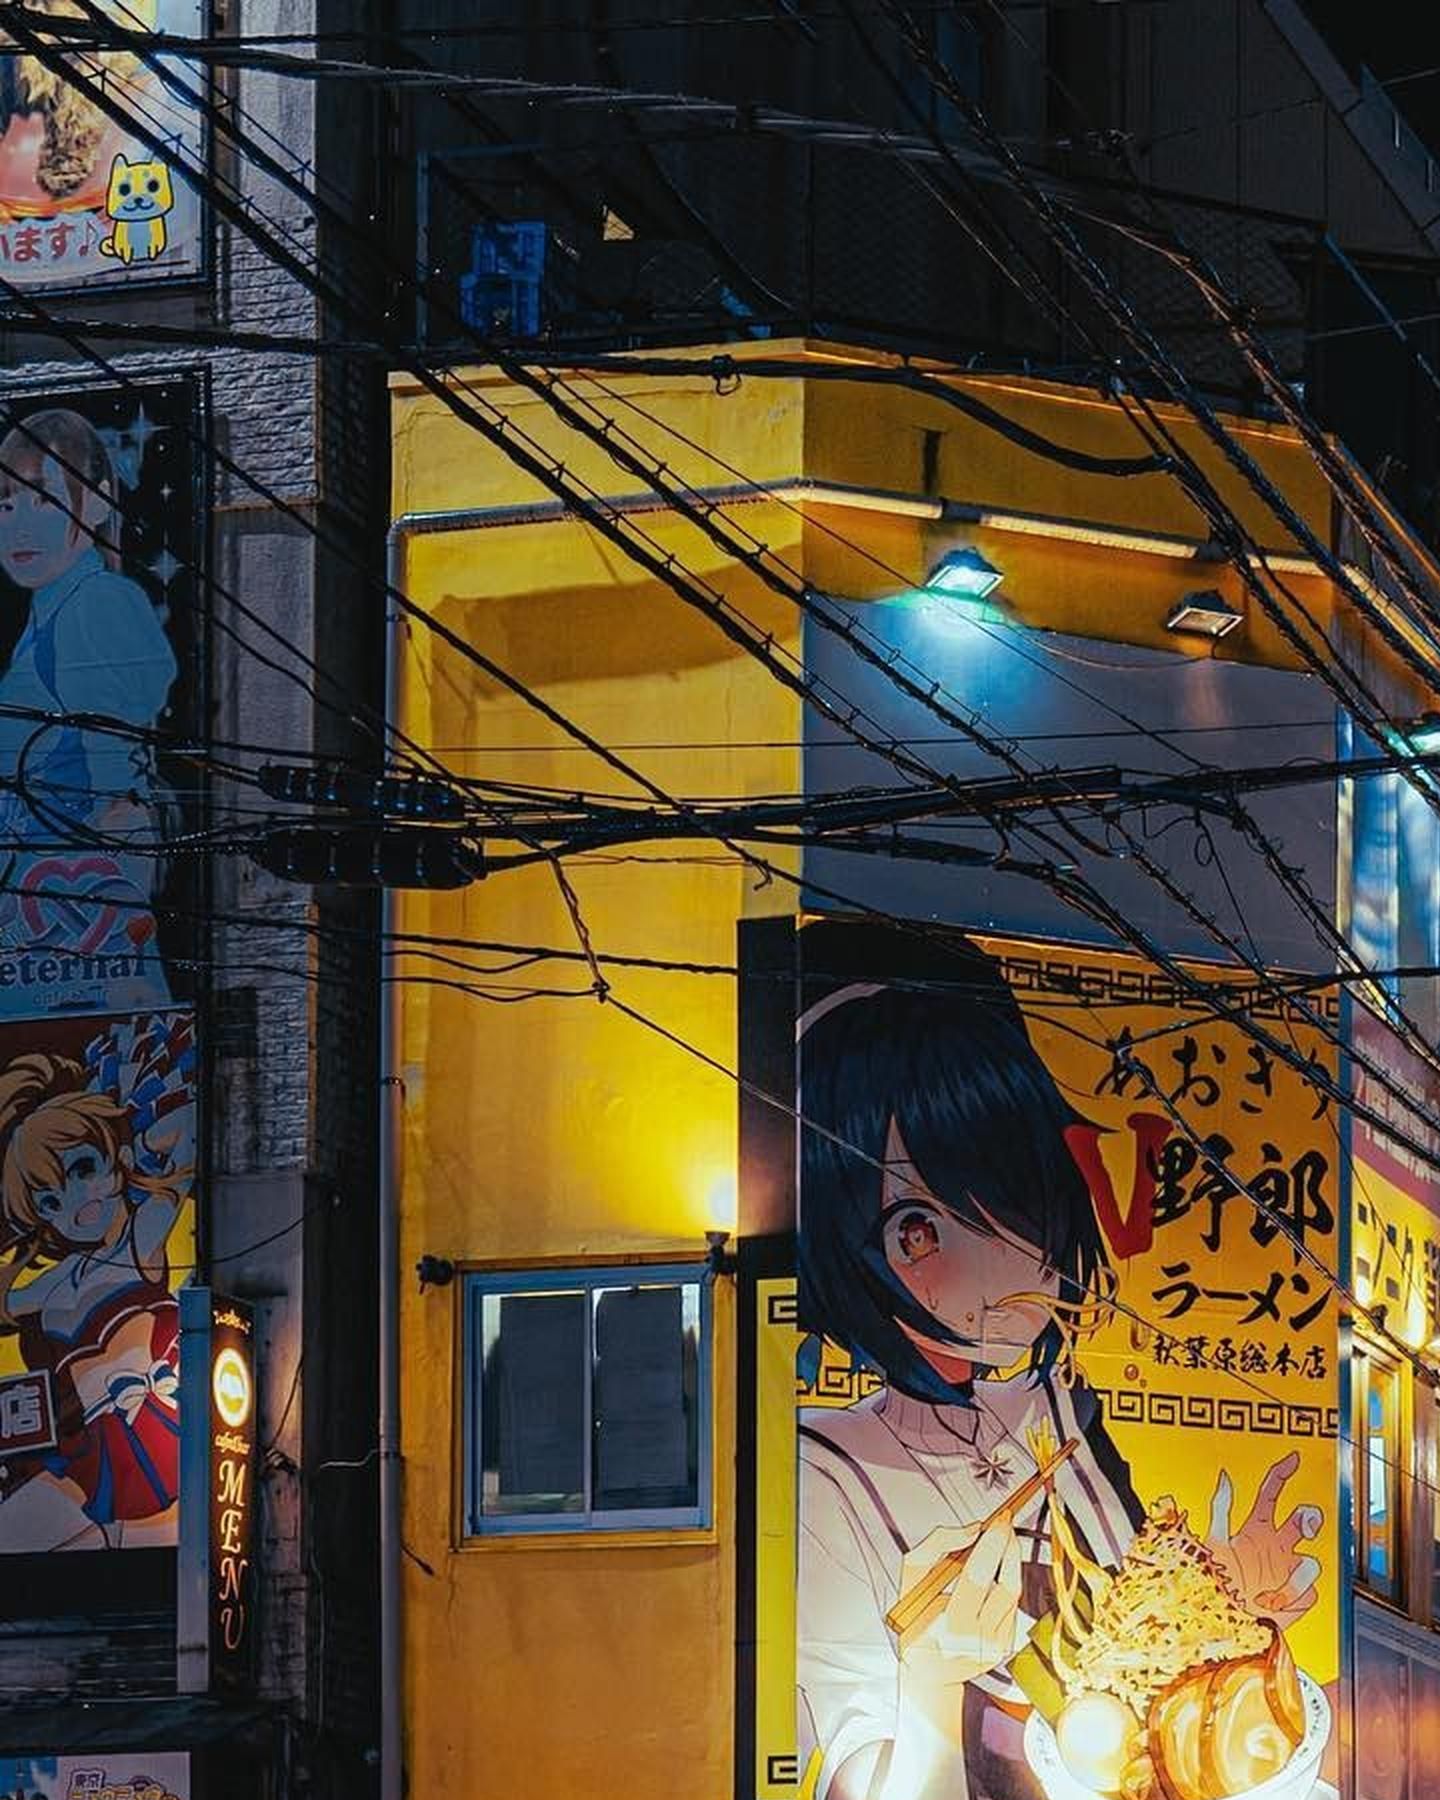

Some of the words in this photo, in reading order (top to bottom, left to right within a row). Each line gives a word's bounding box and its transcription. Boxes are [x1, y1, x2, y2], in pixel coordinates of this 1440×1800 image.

[1152, 1262, 1332, 1332] ラーメン
[1153, 1333, 1327, 1379] 秋葉原総本店
[217, 1459, 248, 1649] MENU
